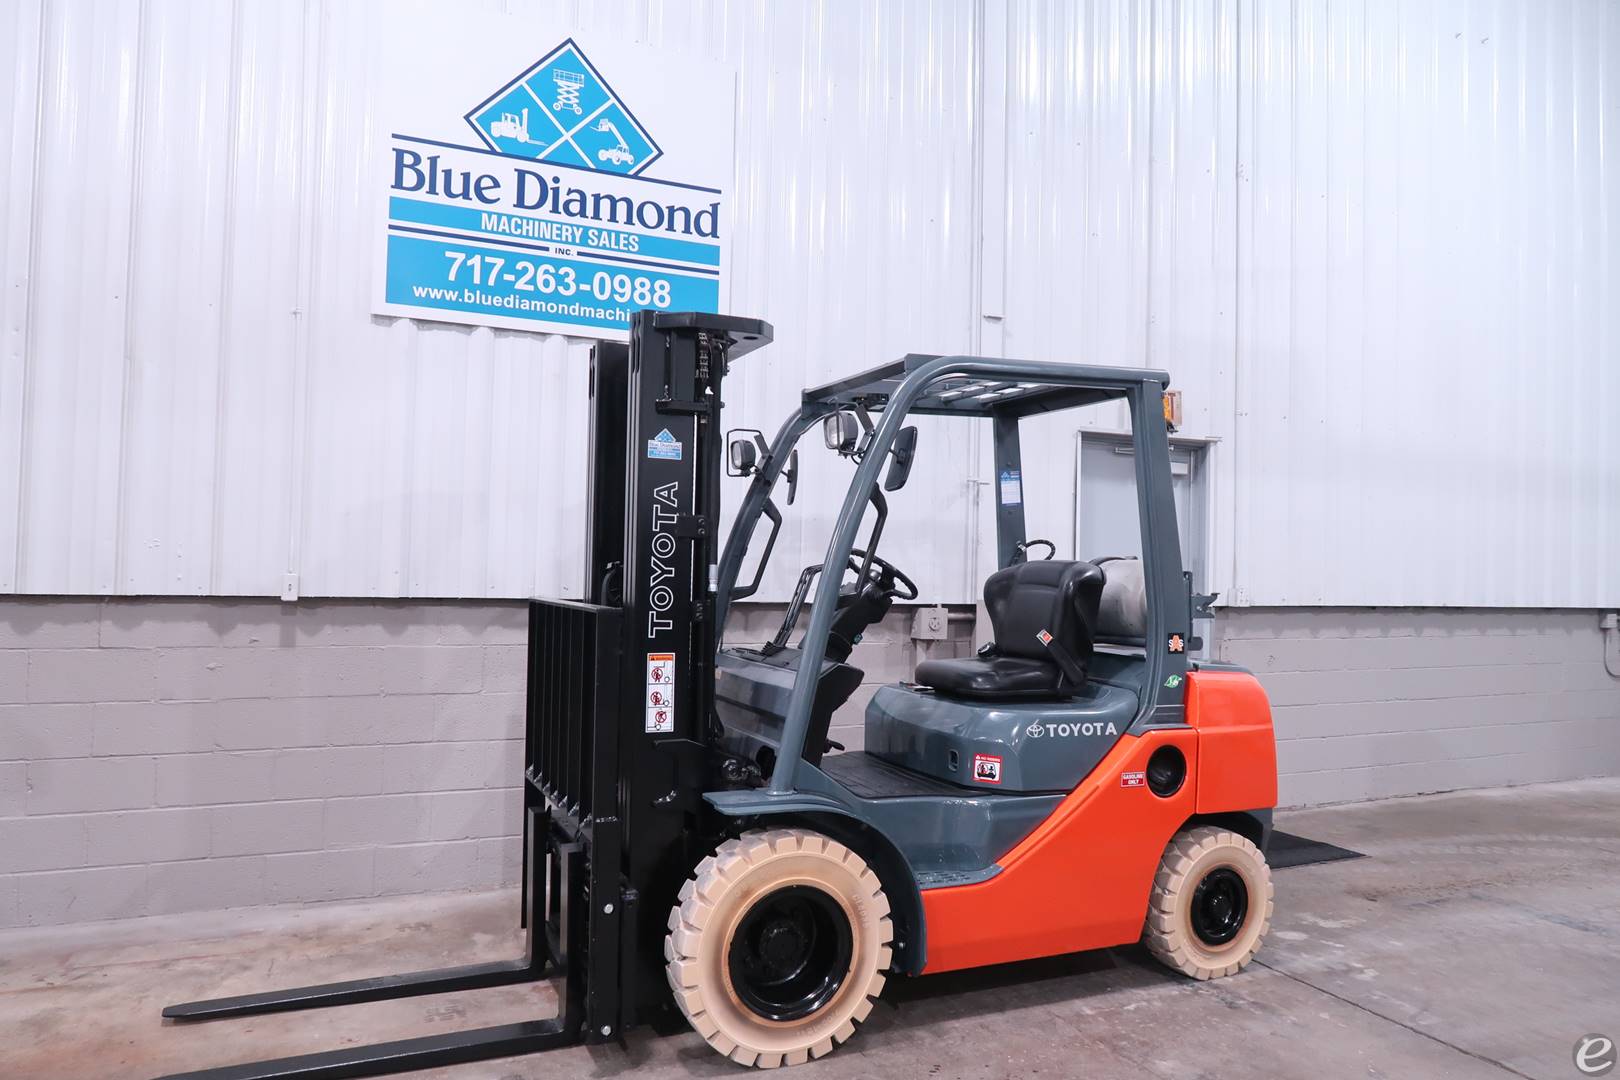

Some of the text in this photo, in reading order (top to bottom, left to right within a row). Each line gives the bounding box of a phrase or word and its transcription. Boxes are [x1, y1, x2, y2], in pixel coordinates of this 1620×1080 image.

[390, 147, 721, 239] Blue Diamond
[480, 212, 640, 253] MACHINERY SALES
[554, 247, 574, 257] INC.
[444, 250, 672, 308] 717-263-0988
[647, 480, 679, 639] TOYOTA
[1045, 721, 1118, 738] TOYOTA
